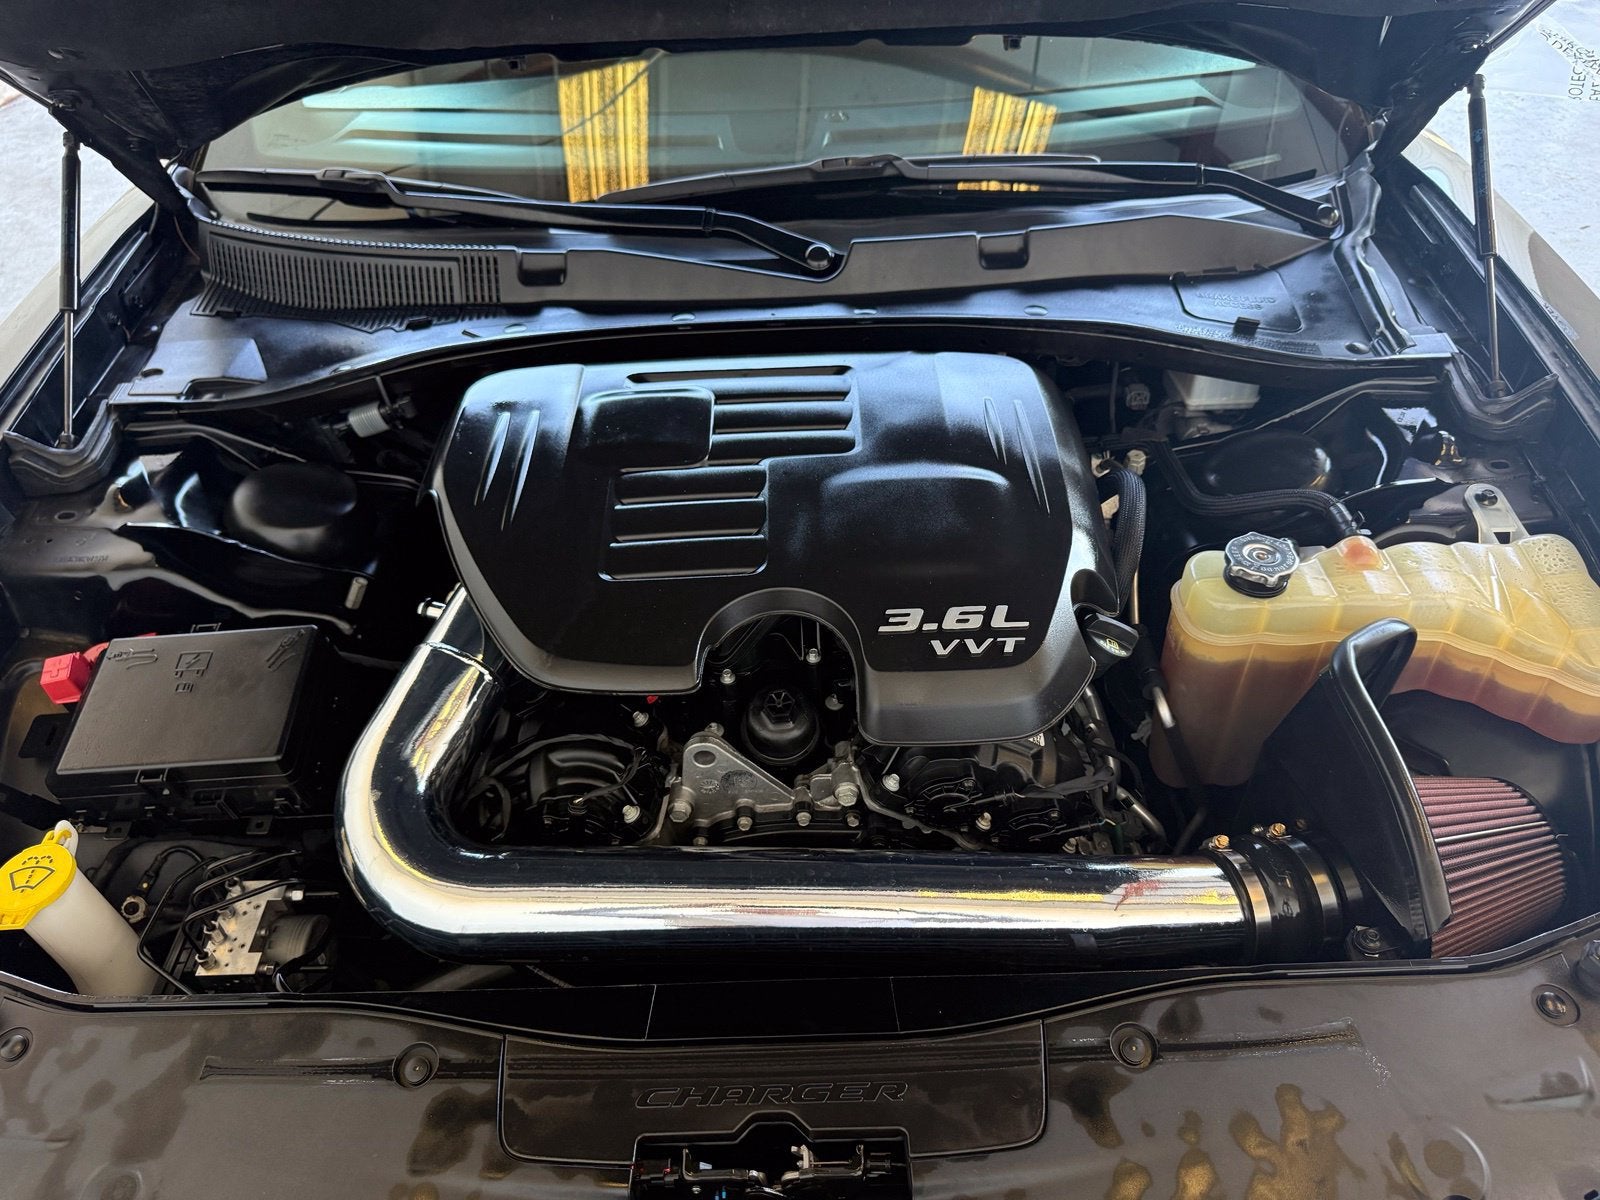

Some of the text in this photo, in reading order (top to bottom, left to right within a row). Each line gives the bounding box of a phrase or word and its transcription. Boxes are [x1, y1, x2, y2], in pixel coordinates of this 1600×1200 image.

[877, 604, 1030, 634] 3.6L
[930, 637, 1026, 657] VVT
[634, 1081, 909, 1109] CHARGER
